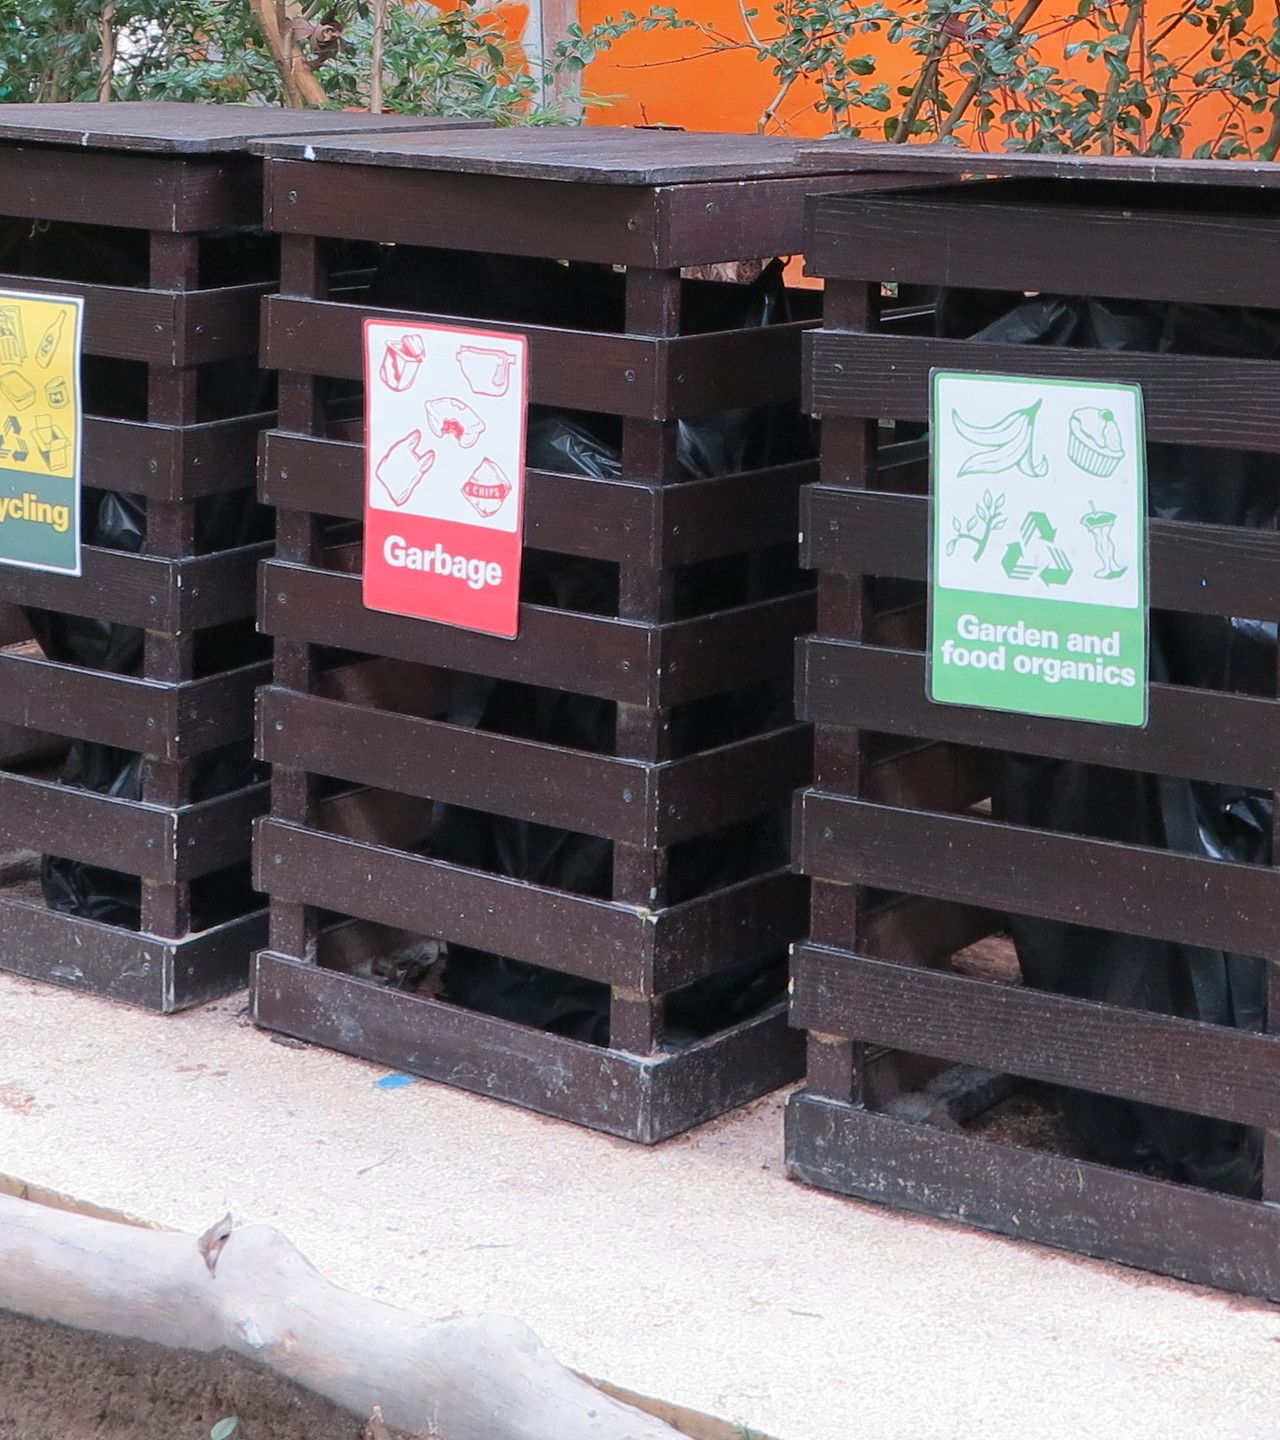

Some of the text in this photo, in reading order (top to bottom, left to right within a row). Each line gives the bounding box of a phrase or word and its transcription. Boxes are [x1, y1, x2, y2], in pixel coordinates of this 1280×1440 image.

[382, 534, 504, 589] Garbage
[956, 613, 1121, 657] Garden and
[941, 639, 1137, 688] food organics
